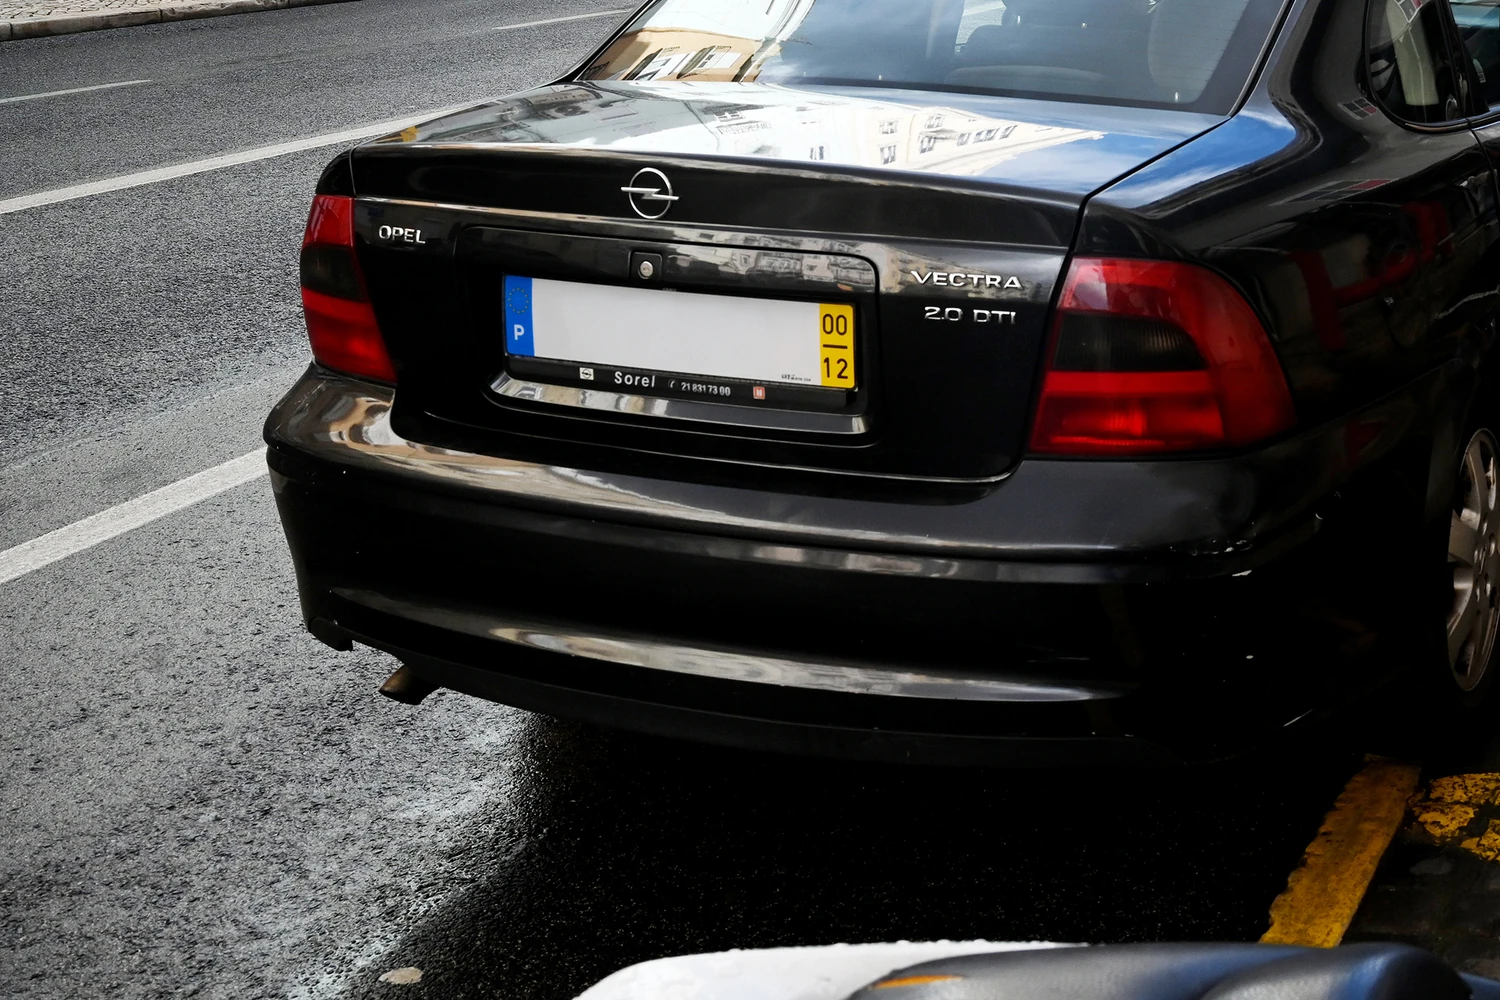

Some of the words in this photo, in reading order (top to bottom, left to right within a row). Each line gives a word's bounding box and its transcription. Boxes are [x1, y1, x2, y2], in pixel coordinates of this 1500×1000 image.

[378, 225, 426, 245] OPEL
[910, 270, 1024, 290] VECTRA
[822, 313, 848, 336] 00
[924, 305, 964, 323] 2.0
[973, 308, 1016, 324] DTI
[514, 324, 525, 341] P
[822, 357, 849, 380] 12
[614, 371, 655, 388] Sorel
